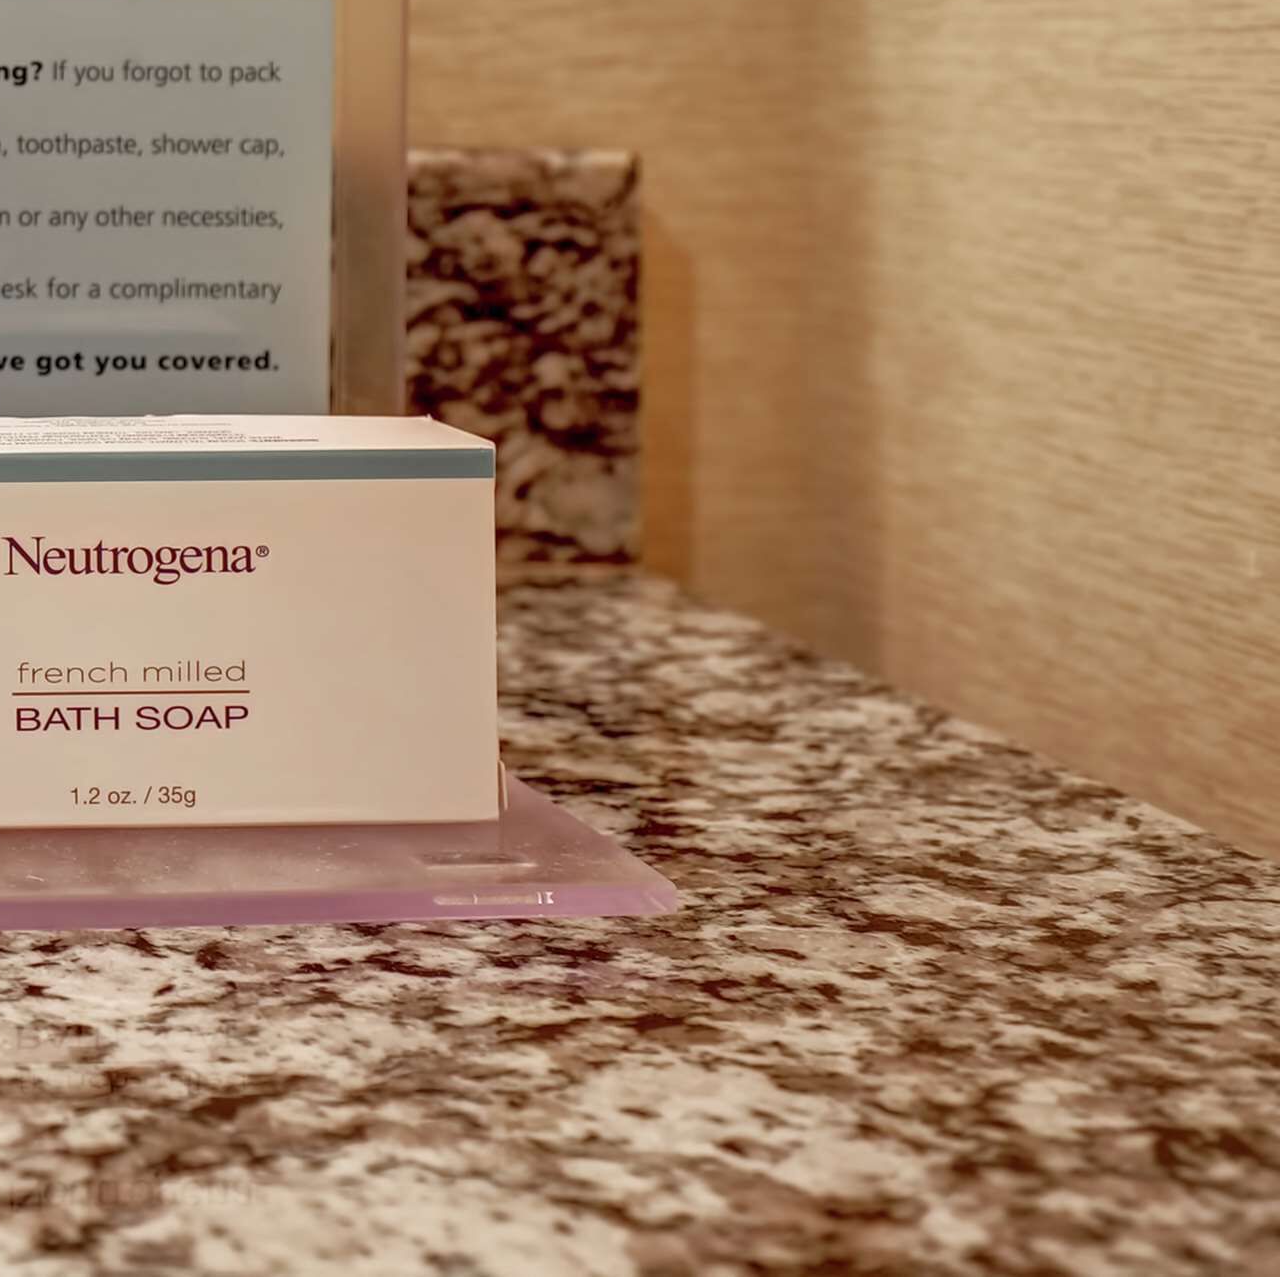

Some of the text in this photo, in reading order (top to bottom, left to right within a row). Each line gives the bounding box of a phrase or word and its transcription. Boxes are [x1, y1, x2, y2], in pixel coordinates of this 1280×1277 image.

[52, 61, 67, 83] If
[73, 65, 114, 87] you
[122, 61, 192, 87] forgot
[199, 63, 223, 83] to
[229, 61, 281, 86] pack
[17, 133, 143, 159] toothpaste,
[151, 133, 233, 155] shower
[238, 138, 285, 159] cap,
[17, 210, 42, 227] or
[48, 209, 86, 232] any
[94, 205, 155, 227] other
[162, 207, 283, 230] necessities,
[46, 276, 80, 300] for
[87, 283, 101, 299] a
[108, 278, 282, 304] complimentary
[36, 352, 83, 376] got
[95, 355, 146, 376] you
[158, 350, 278, 371] covered.
[17, 660, 246, 684] french milled
[16, 705, 249, 731] BATH SOAP
[71, 786, 196, 808] 1.2 oz. / 35g
